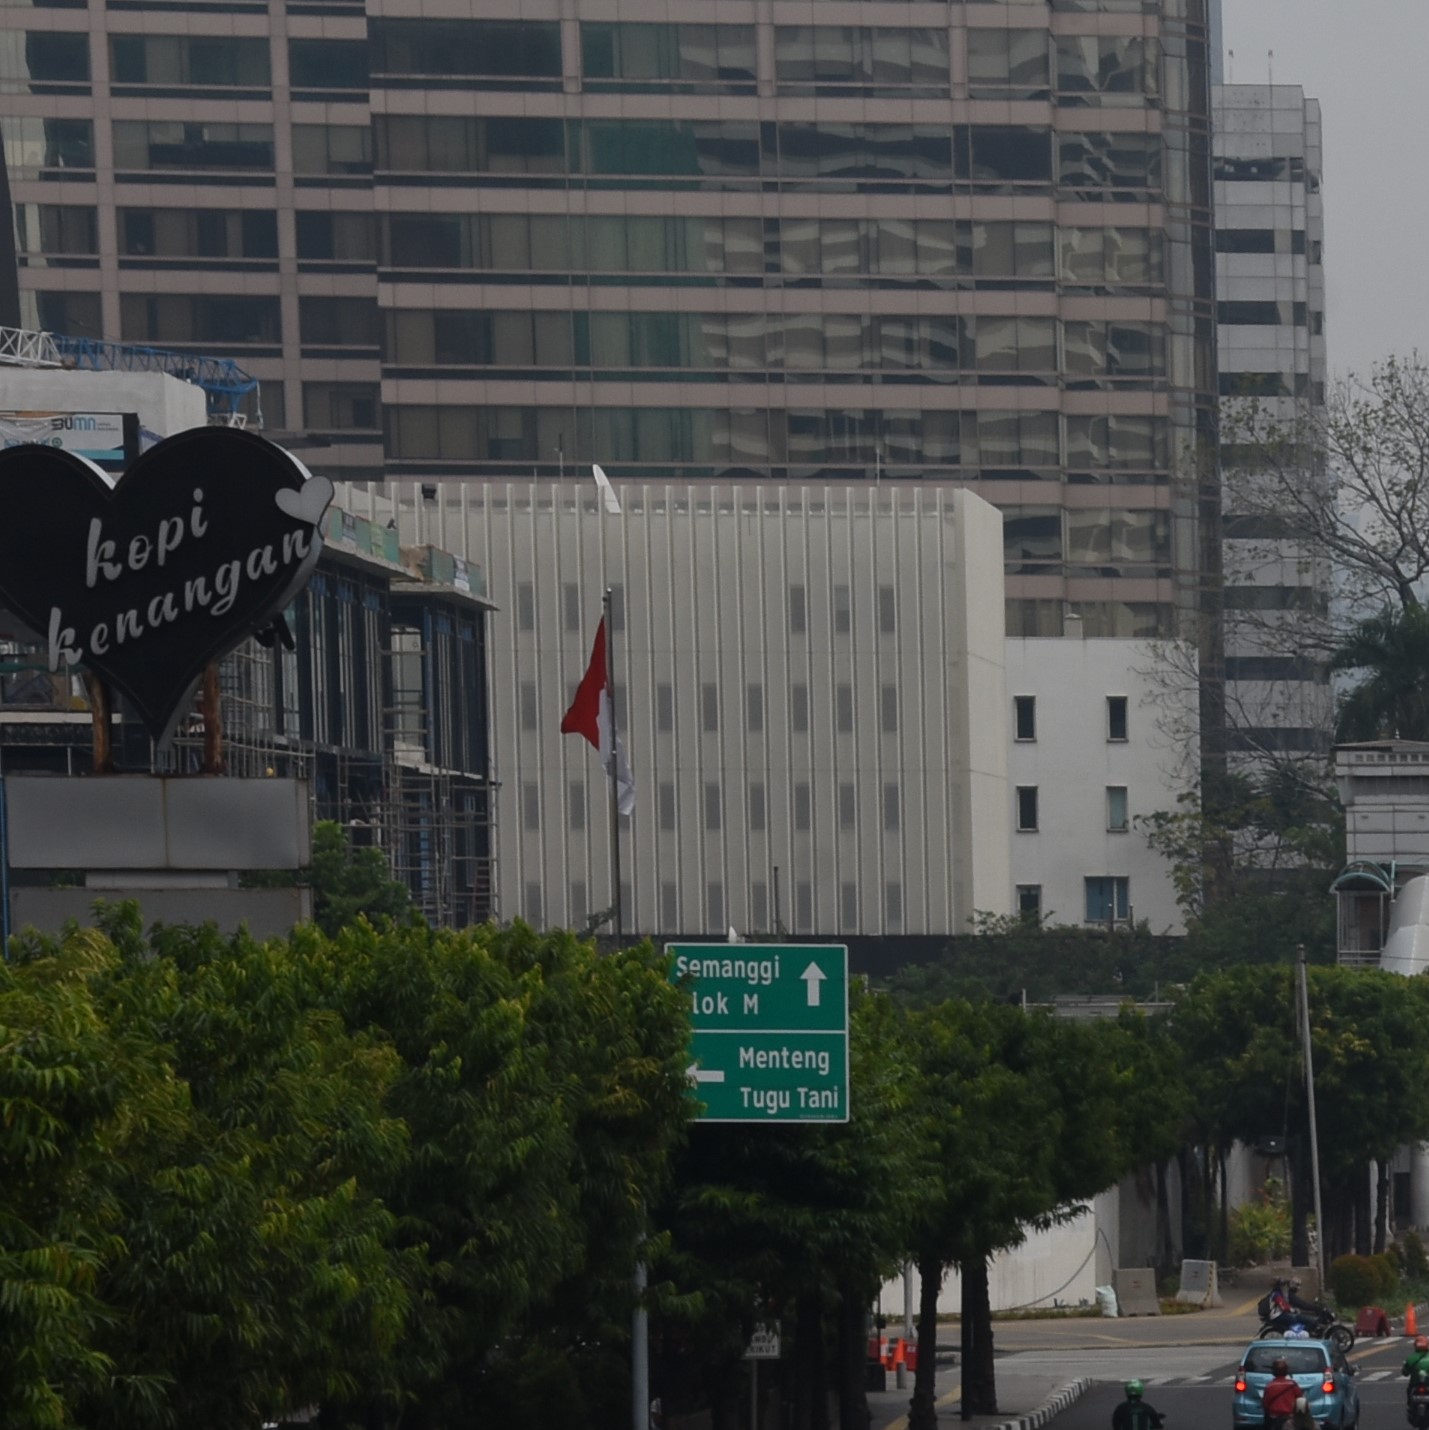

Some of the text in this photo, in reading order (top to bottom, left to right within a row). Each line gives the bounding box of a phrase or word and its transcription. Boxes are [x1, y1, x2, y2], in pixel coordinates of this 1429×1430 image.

[86, 488, 209, 588] kopi
[48, 529, 310, 672] kenangan
[676, 955, 780, 985] Semanggi
[691, 991, 759, 1015] lok M
[739, 1047, 830, 1076] Menteng
[740, 1086, 839, 1115] Tugu Tani
